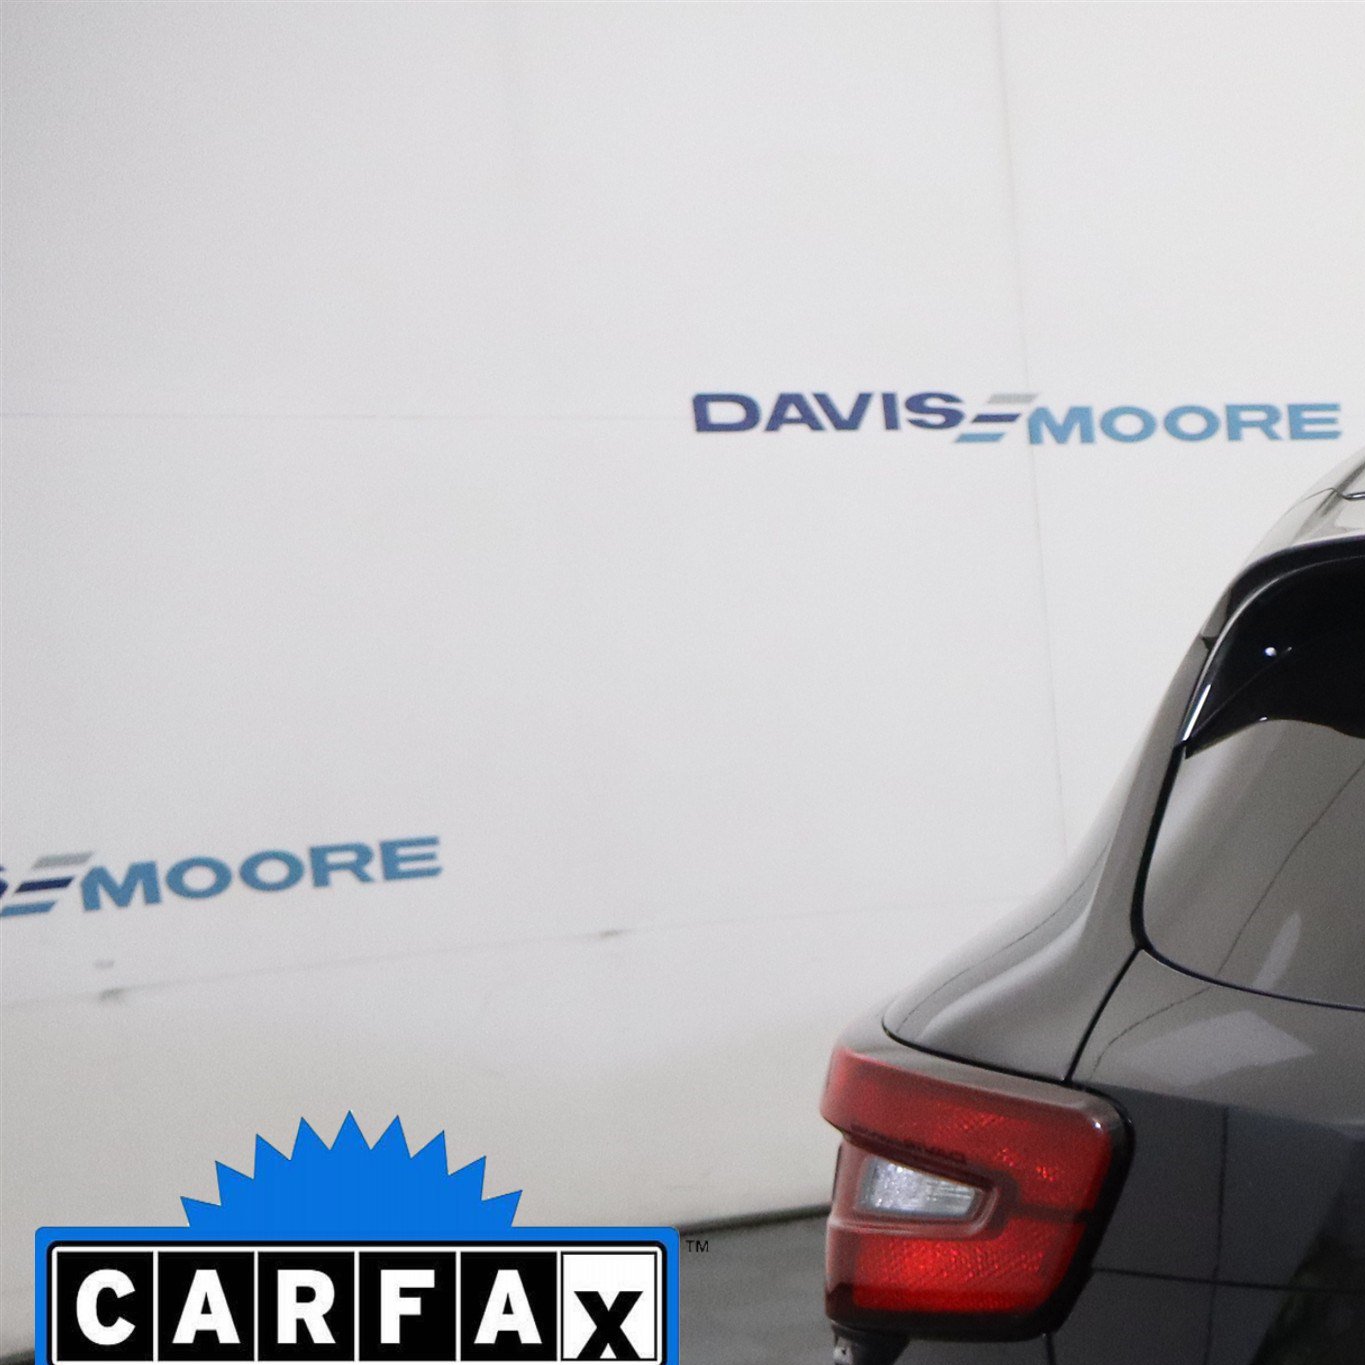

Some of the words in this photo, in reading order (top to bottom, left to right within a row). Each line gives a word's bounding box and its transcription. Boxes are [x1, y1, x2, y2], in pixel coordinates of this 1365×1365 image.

[693, 390, 966, 433] DAVIS
[1027, 400, 1344, 446] MOORE
[80, 834, 444, 913] MOORE
